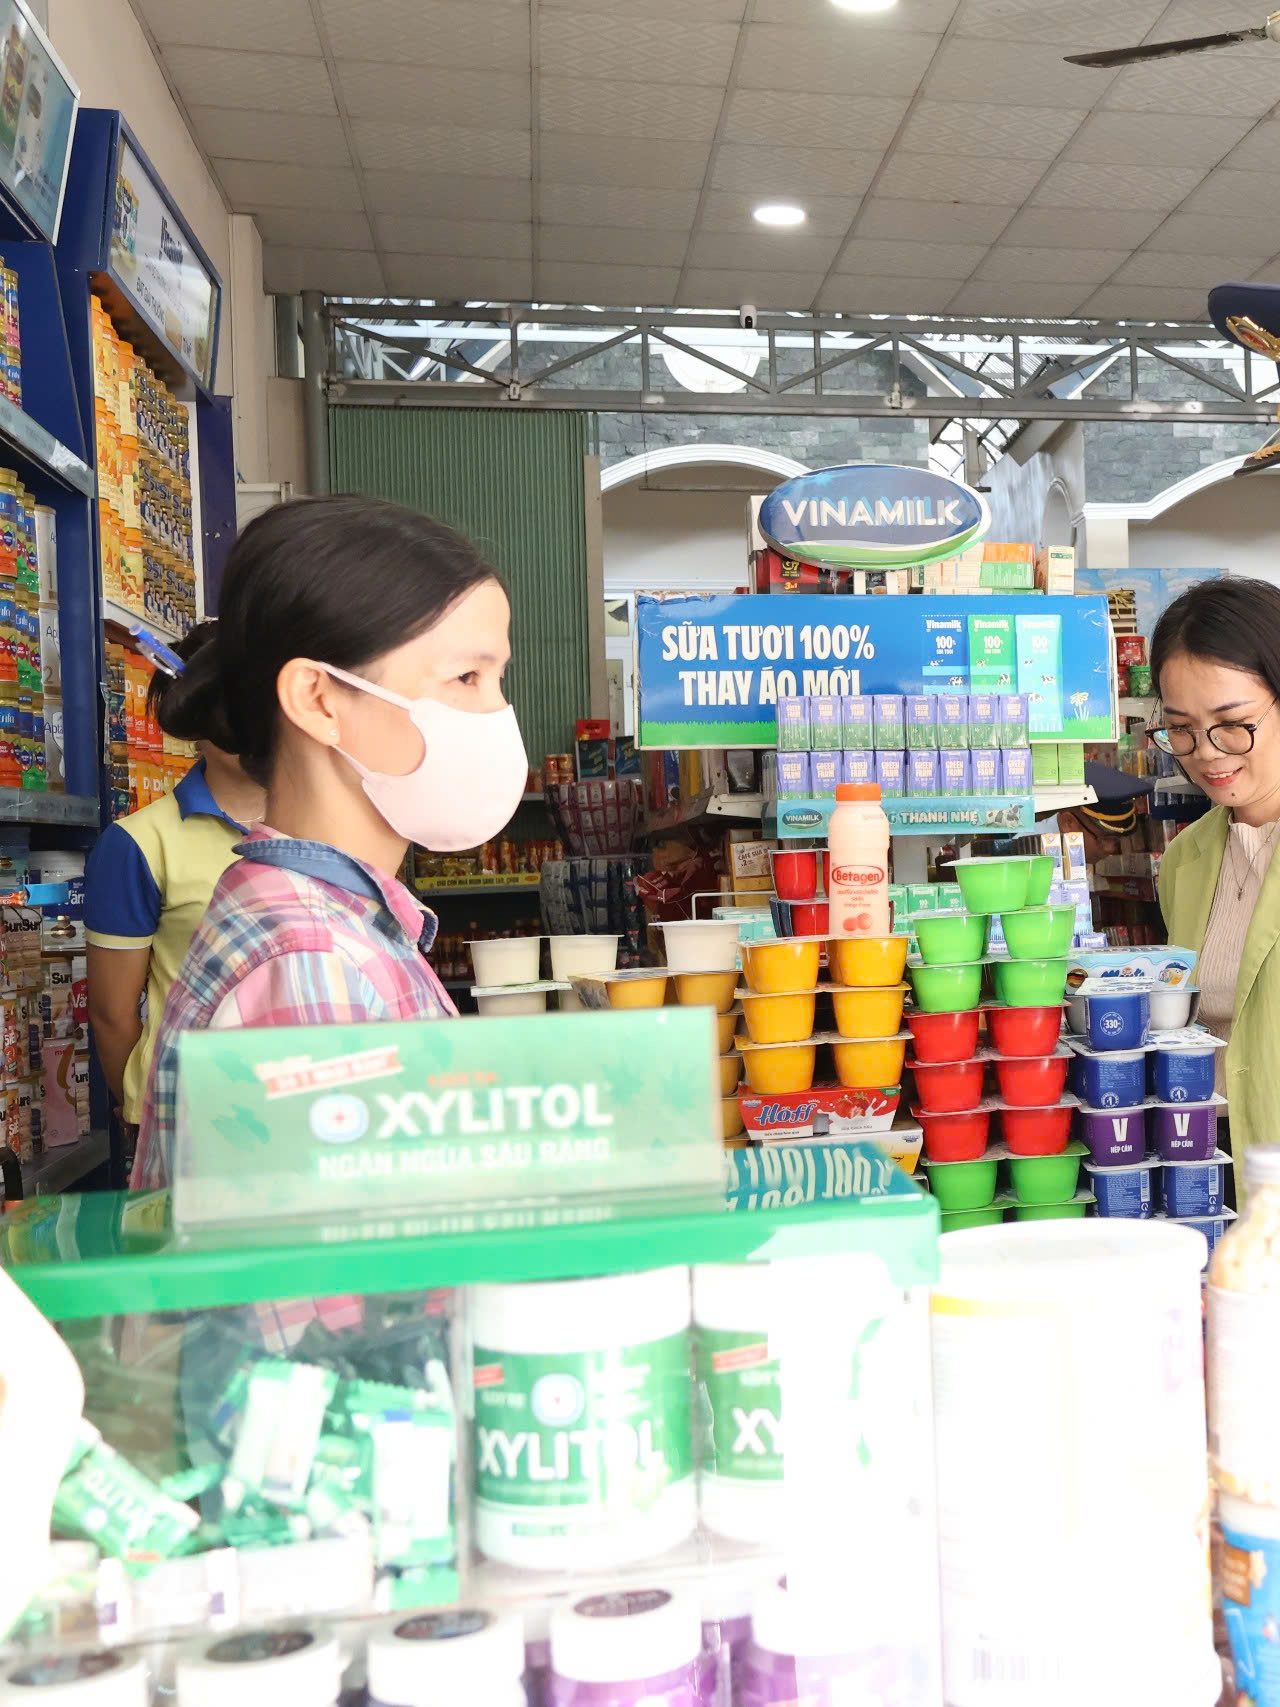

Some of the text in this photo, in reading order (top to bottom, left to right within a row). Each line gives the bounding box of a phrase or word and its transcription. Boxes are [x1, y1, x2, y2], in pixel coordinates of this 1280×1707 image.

[781, 497, 964, 527] VINAMILK
[661, 620, 875, 661] SỮA TƯƠI 100%
[678, 665, 861, 706] THAY ÁO MỚI
[785, 813, 821, 823] VINAMILK
[900, 811, 947, 824] THANH
[951, 811, 978, 826] NHẸ
[836, 870, 880, 884] Betagen
[375, 1082, 614, 1139] XYLITOL
[755, 1103, 817, 1126] Höff
[1111, 1117, 1129, 1142] V
[1173, 1113, 1191, 1137] V
[478, 1418, 653, 1481] XYLITL
